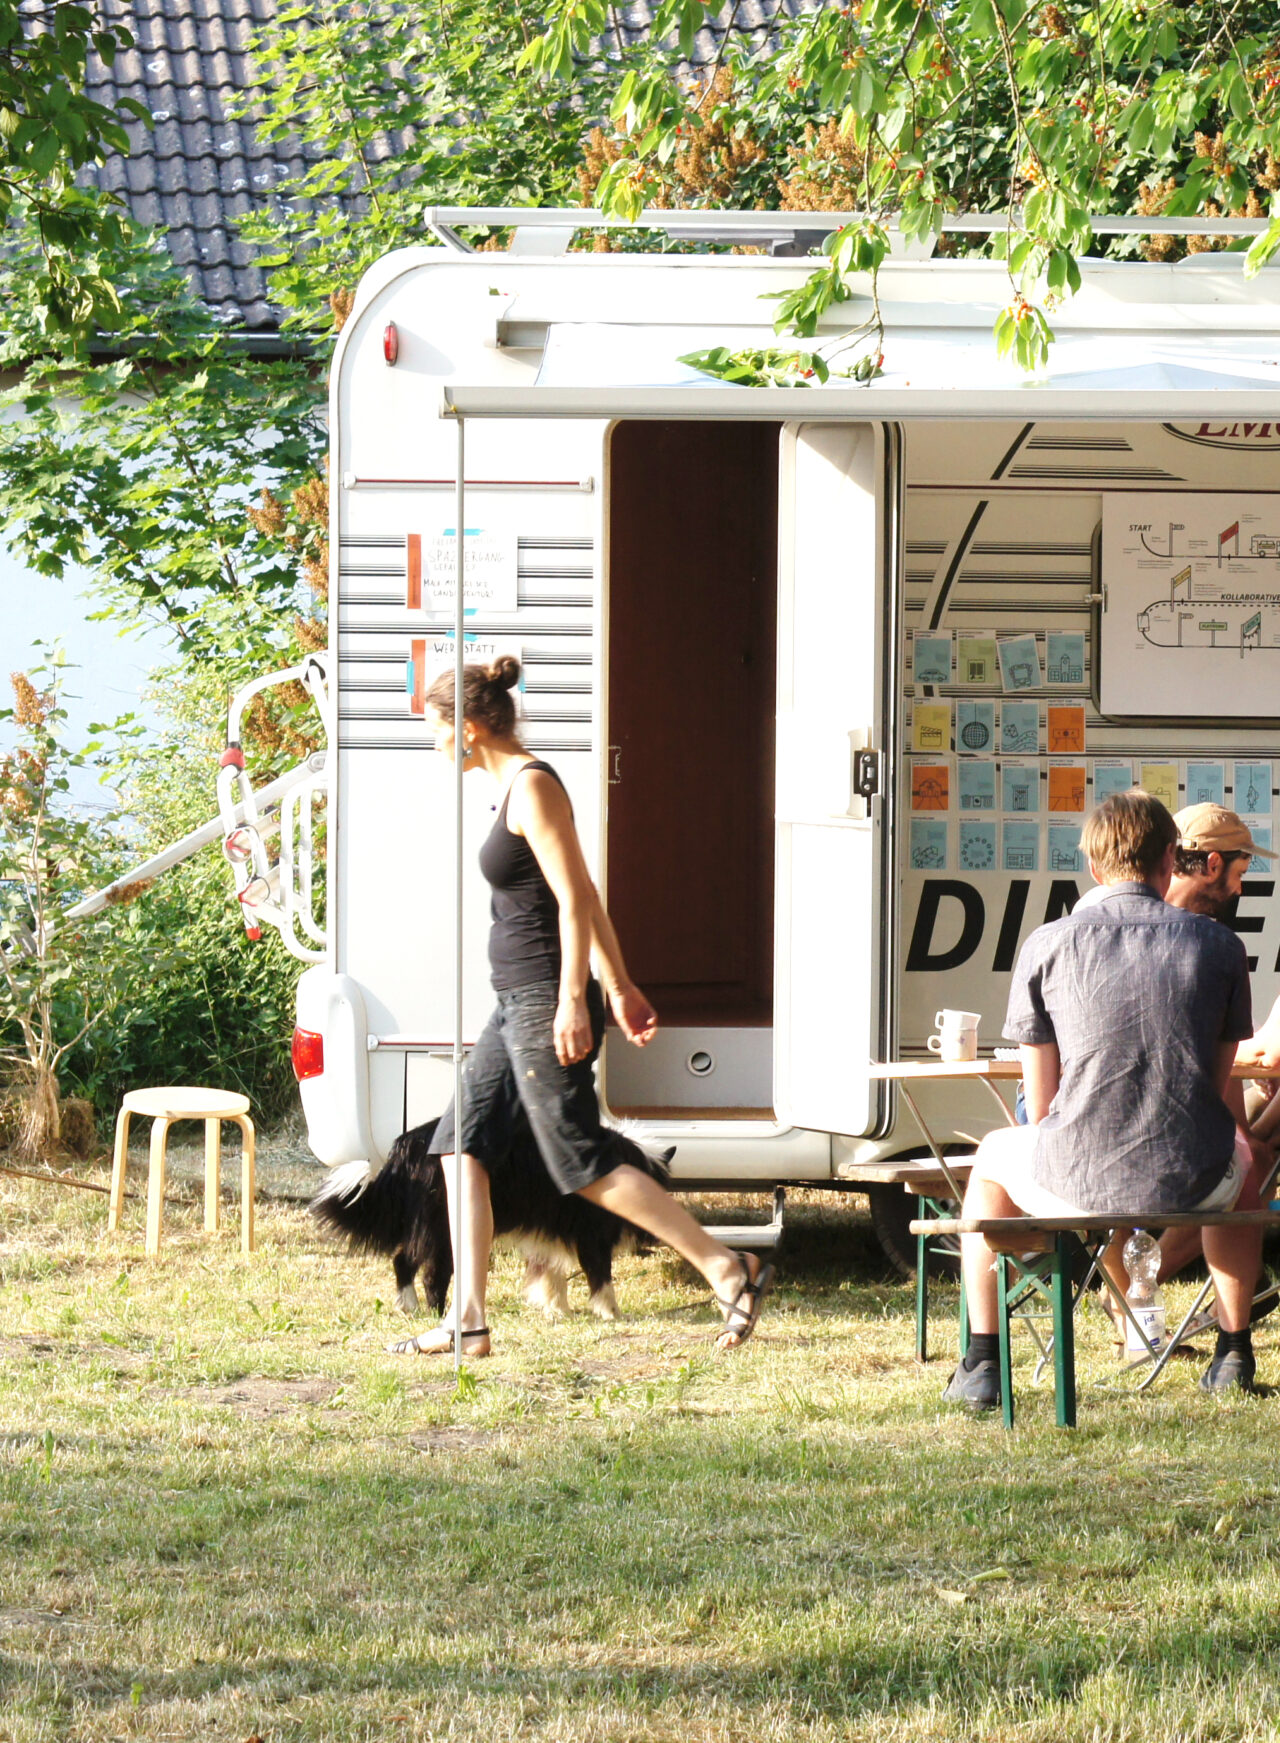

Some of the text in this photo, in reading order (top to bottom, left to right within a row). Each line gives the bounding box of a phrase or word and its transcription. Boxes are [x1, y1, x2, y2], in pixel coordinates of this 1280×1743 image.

[1129, 524, 1152, 532] START
[427, 549, 504, 563] SPAZERGANG
[1220, 593, 1280, 601] KOLLABORATIVE
[433, 642, 496, 655] WERSTATT
